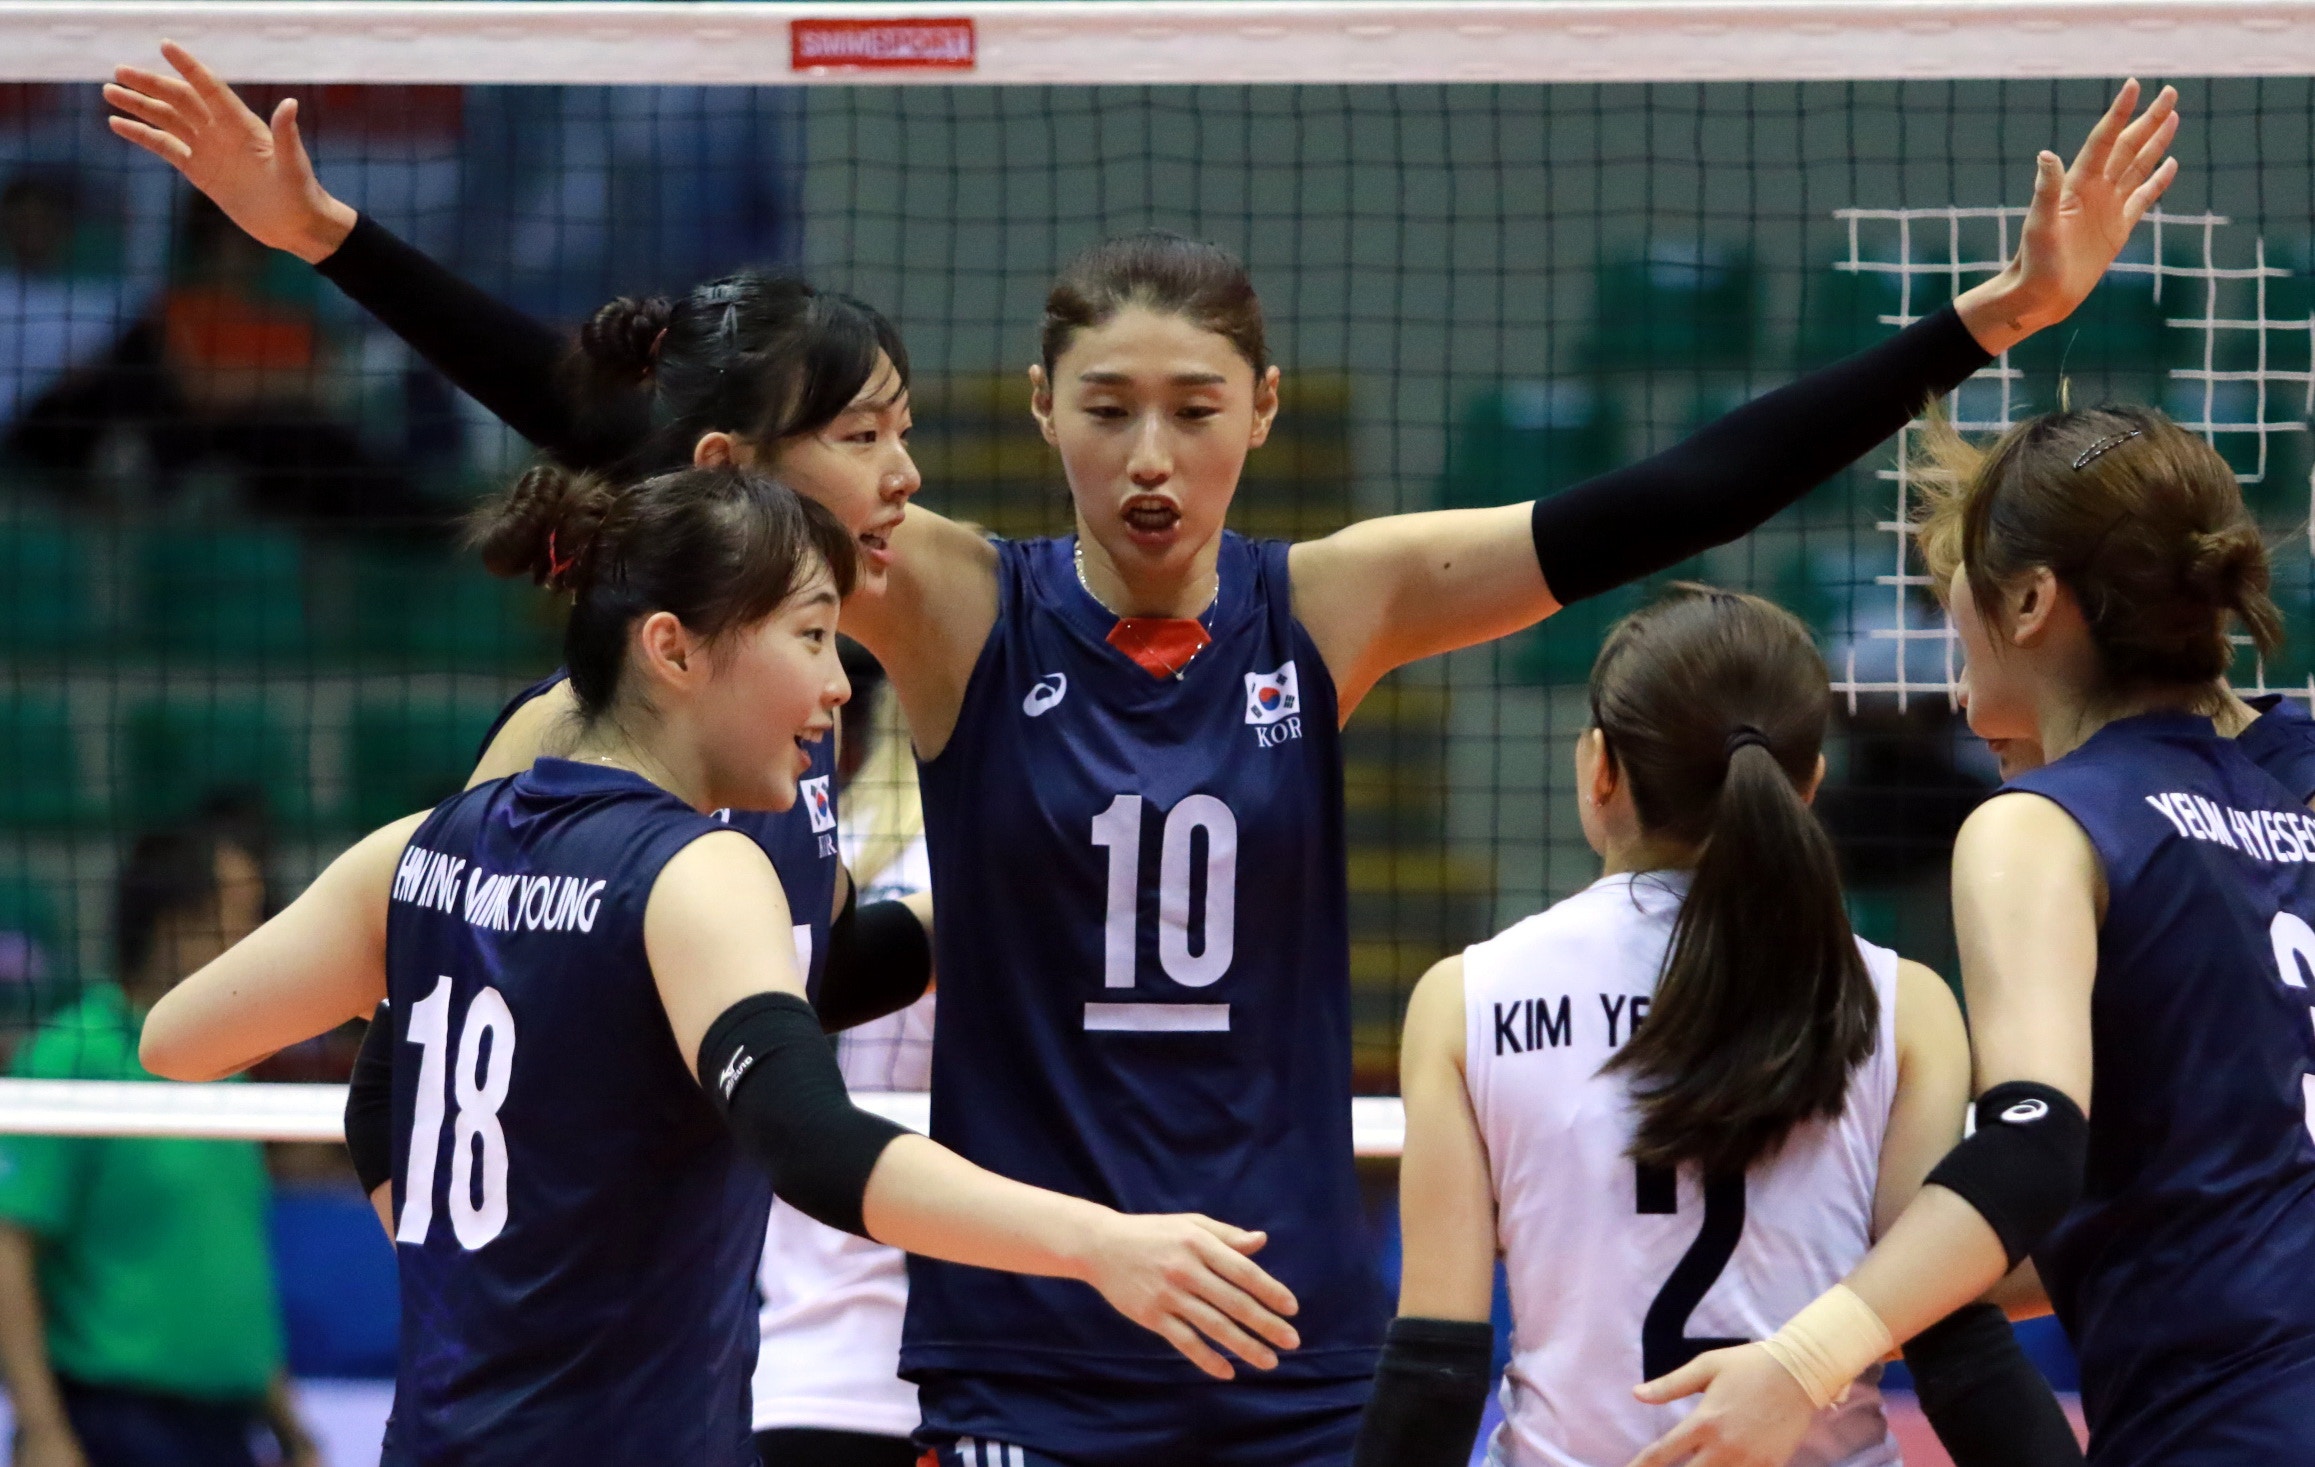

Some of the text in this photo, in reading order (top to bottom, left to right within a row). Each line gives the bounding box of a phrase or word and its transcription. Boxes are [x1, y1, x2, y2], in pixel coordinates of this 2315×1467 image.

[1255, 716, 1303, 748] KOR
[1091, 794, 1237, 988] 10
[396, 975, 515, 1250] 18
[1494, 995, 1572, 1057] KIM
[1636, 1158, 1751, 1384] 2
